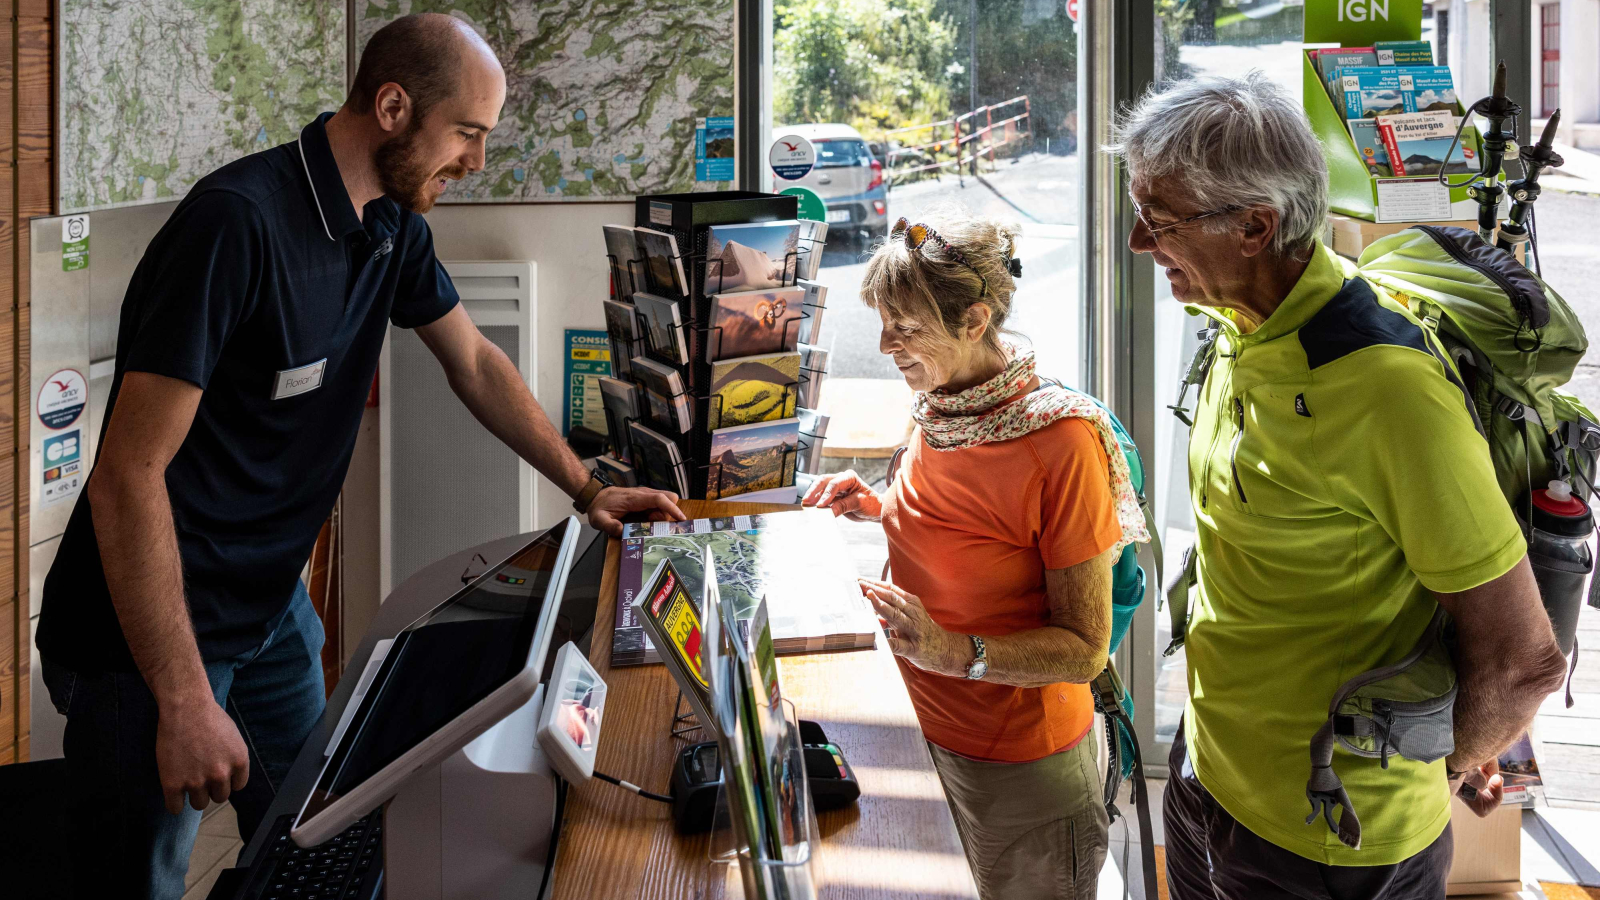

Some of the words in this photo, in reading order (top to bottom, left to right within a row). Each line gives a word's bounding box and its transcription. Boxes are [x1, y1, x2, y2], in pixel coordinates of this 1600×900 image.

[1338, 0, 1388, 22] IGN
[1337, 56, 1363, 65] MASSIF
[1396, 122, 1444, 132] d'Auvergne
[286, 376, 312, 388] Florian
[62, 388, 78, 398] ancv
[64, 464, 78, 473] VISA
[666, 593, 686, 630] AUVERGNE
